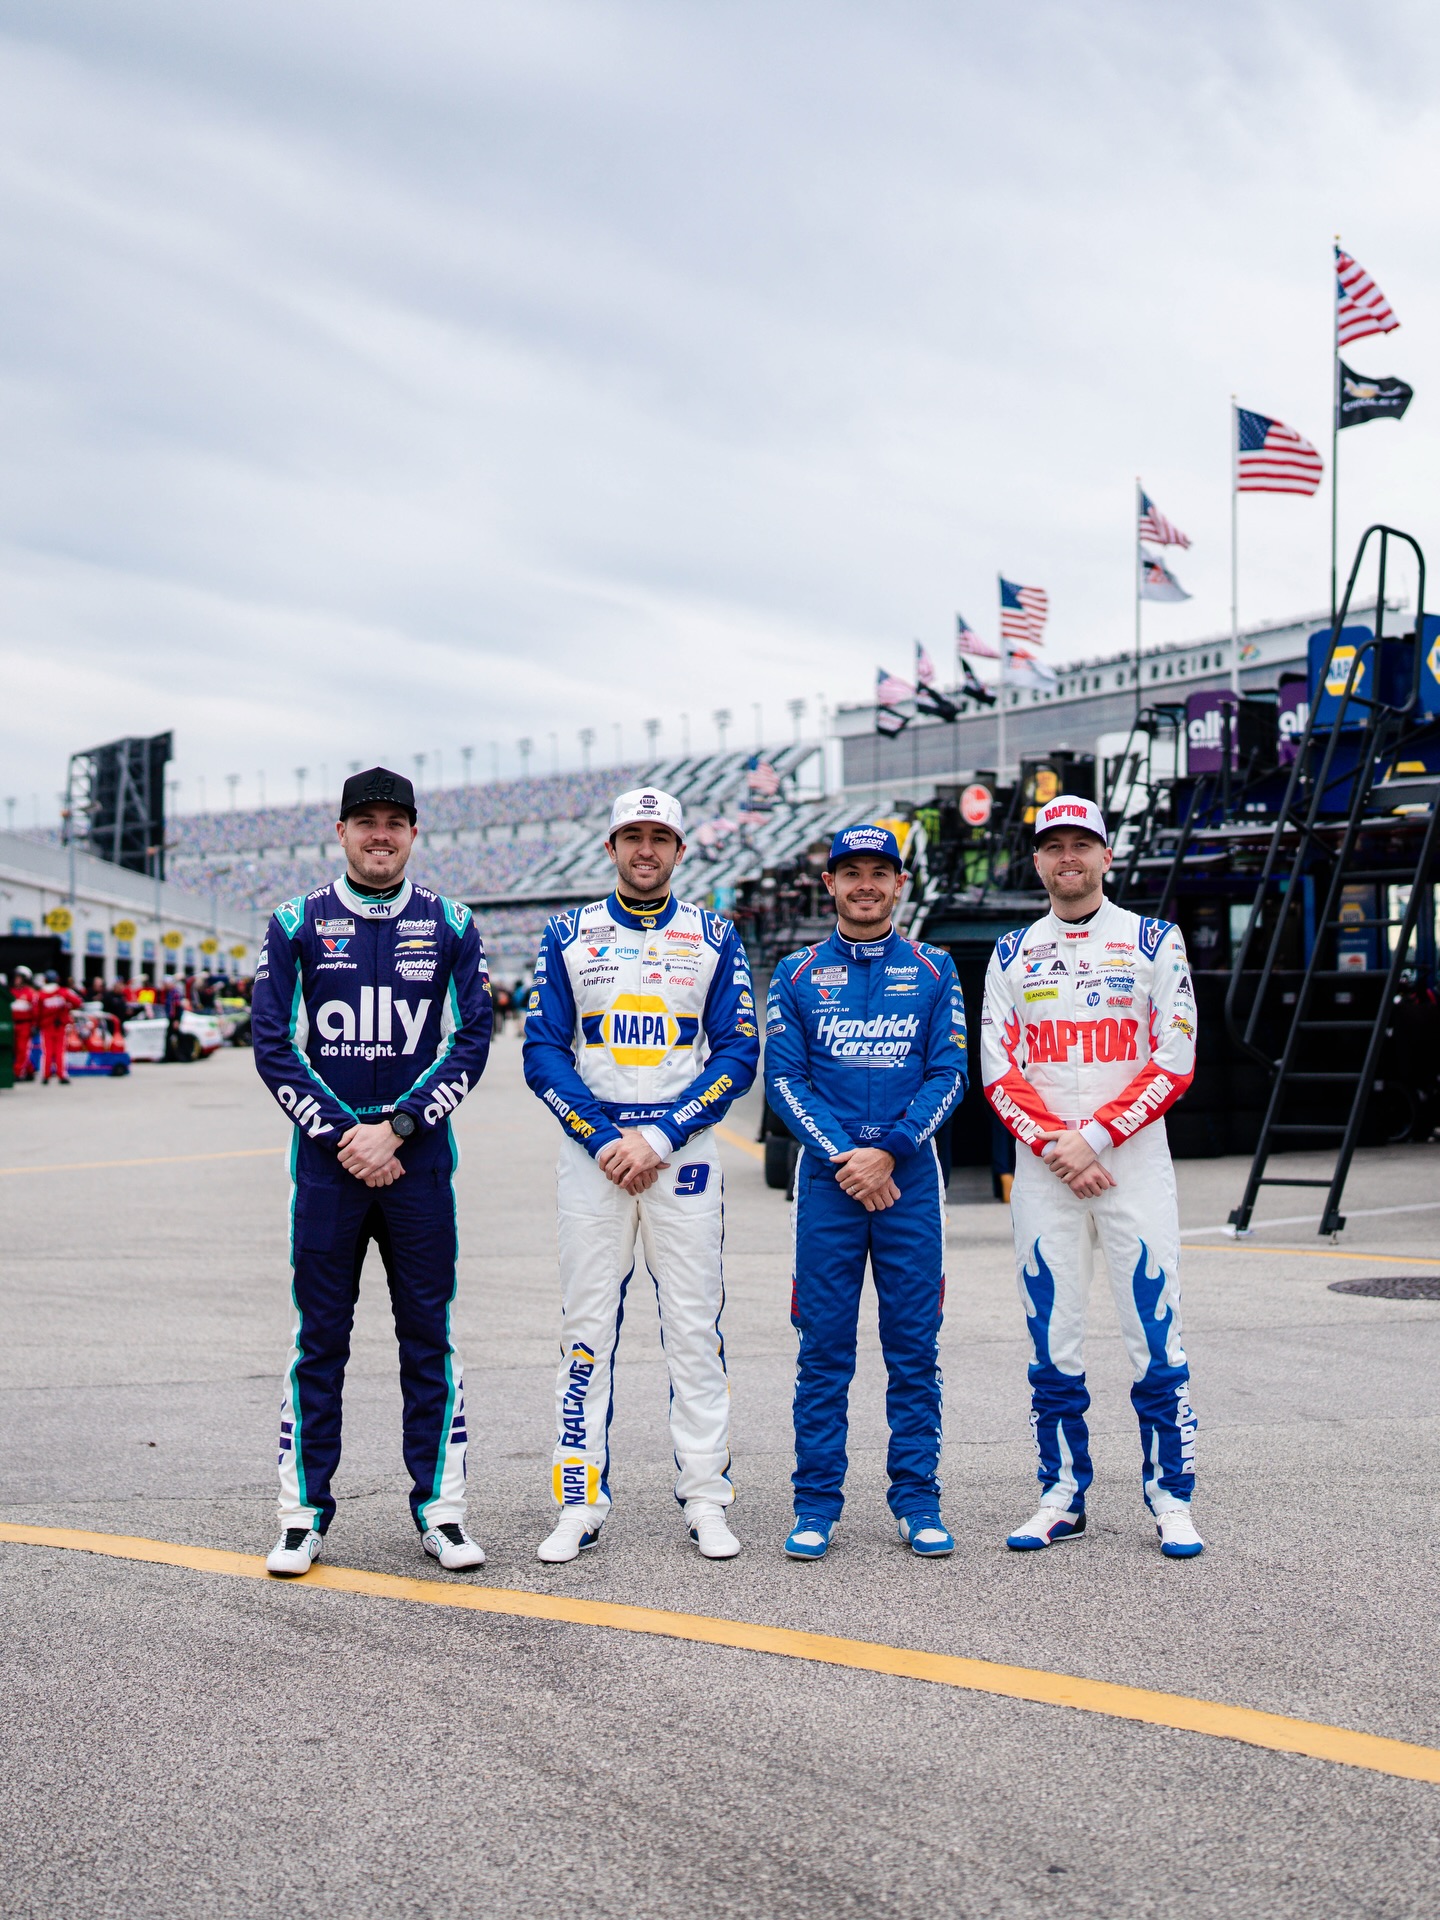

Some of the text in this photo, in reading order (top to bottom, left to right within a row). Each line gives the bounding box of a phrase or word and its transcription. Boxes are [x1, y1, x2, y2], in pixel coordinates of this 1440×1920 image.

[1152, 652, 1222, 679] RACING
[1279, 702, 1310, 733] all
[642, 798, 657, 806] NAPA
[1044, 804, 1088, 822] RAPTOR
[841, 828, 889, 844] Hendrick
[849, 837, 884, 847] Cars.com
[307, 886, 331, 901] ally
[414, 886, 438, 903] ally
[369, 904, 392, 916] ally
[584, 903, 604, 915] NAPA
[396, 919, 438, 931] Hendrick
[664, 929, 703, 941] Hendrick
[1065, 931, 1089, 939] RAPTOR
[615, 946, 640, 955] prime
[1104, 941, 1136, 951] Hendrick
[316, 961, 358, 970] GOODYEAR
[395, 959, 438, 973] Hendrick
[579, 964, 619, 976] GOODYEAR
[884, 965, 919, 976] Hendrick
[401, 969, 434, 979] Cars.com
[583, 976, 615, 987] UniFirst
[1104, 976, 1136, 985] Hendrick
[1022, 979, 1059, 989] GOODYEAR
[1032, 990, 1056, 998] ANDURIL
[811, 1006, 850, 1014] GOODYEAR
[316, 985, 432, 1055] ally
[613, 1014, 666, 1046] NAPA
[816, 1013, 920, 1047] Hendrick
[830, 1039, 912, 1056] Cars.com
[1025, 1018, 1138, 1064] RAPTOR
[320, 1042, 396, 1062] do it right.
[423, 1071, 470, 1126] ally
[672, 1074, 733, 1126] AUTO PARTS
[1110, 1073, 1175, 1137] RAPTOR
[277, 1085, 334, 1139] ally
[543, 1087, 597, 1139] AUTO PARTS
[619, 1109, 670, 1121] ELLIO
[773, 1076, 807, 1119] Hendrick
[800, 1115, 839, 1156] Cars.com
[990, 1084, 1046, 1145] RAPTOR
[915, 1106, 945, 1147] Hendrick
[673, 1161, 711, 1197] 9
[561, 1359, 595, 1450] RACING
[563, 1465, 585, 1505] NAPA
